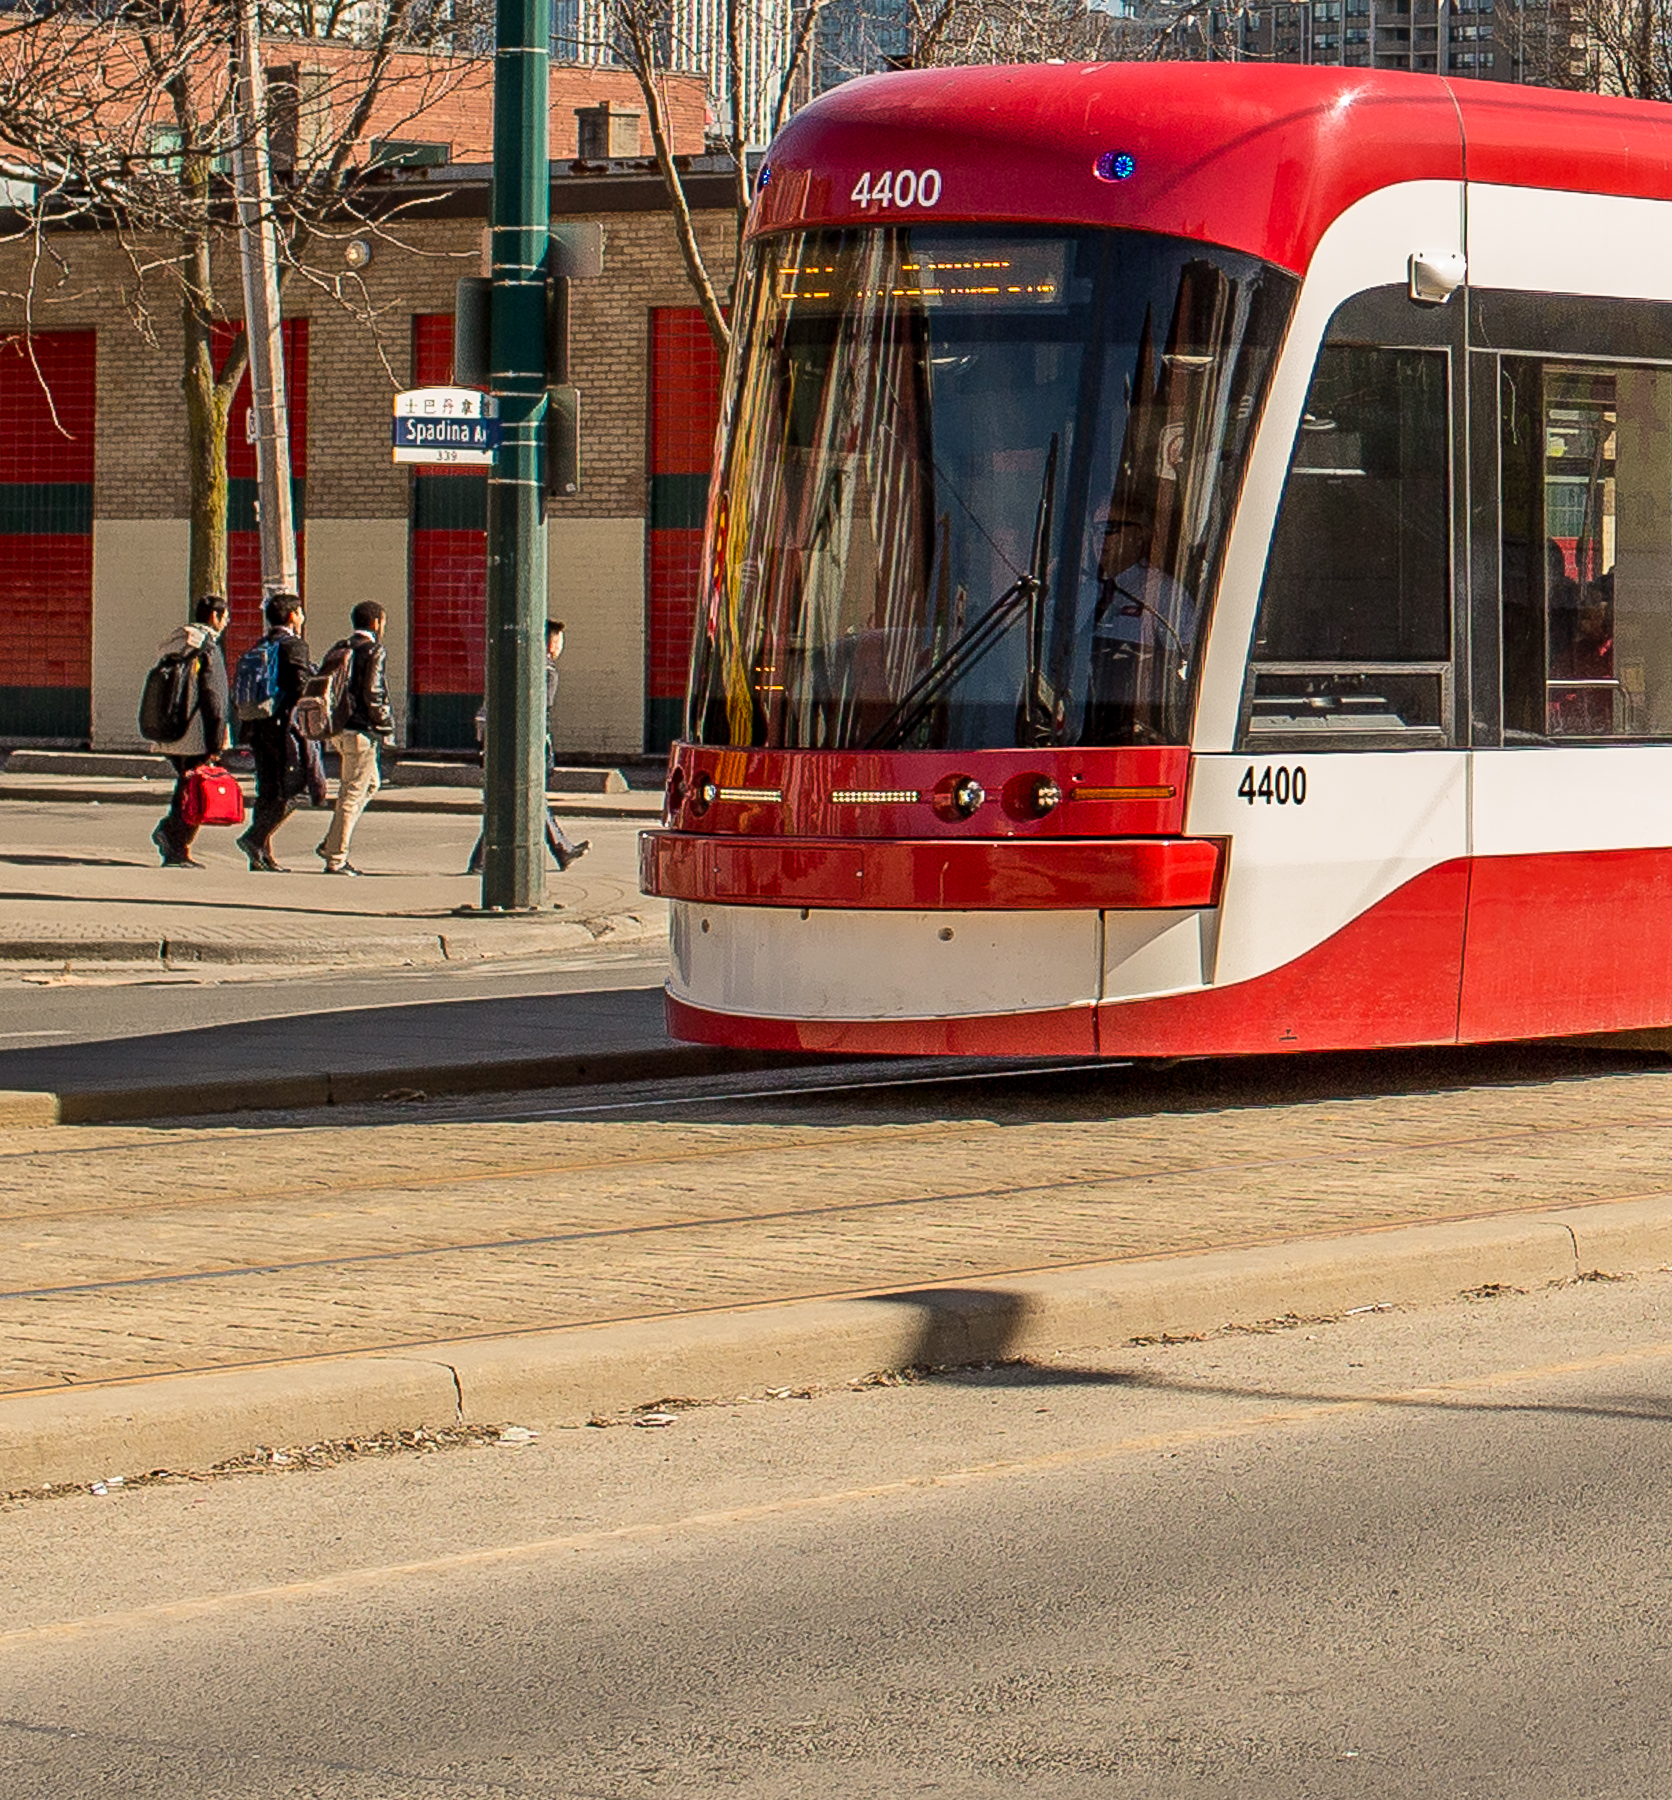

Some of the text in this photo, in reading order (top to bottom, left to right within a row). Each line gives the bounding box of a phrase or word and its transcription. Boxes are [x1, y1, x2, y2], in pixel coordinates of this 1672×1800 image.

[851, 169, 942, 208] 4400
[406, 419, 469, 445] Spadina
[1237, 765, 1307, 805] 4400
